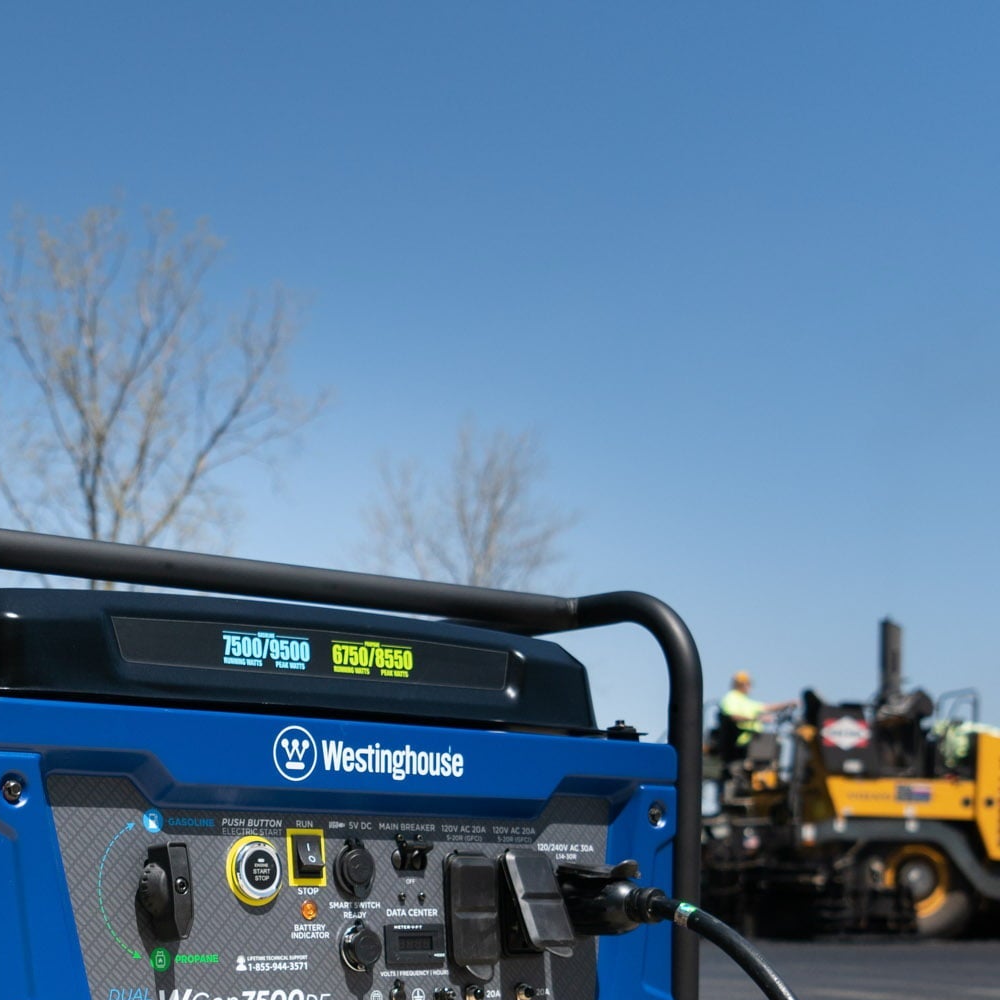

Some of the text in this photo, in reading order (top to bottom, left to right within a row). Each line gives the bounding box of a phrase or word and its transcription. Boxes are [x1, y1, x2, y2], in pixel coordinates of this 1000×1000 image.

[222, 634, 310, 662] 7500/9500
[332, 644, 413, 670] 6750/8550
[321, 740, 464, 781] Westinghouse
[168, 818, 216, 828] GASOLINE
[221, 818, 283, 828] PUSH BUTTON
[296, 820, 314, 828] RUN
[348, 822, 360, 830] 5V
[360, 822, 373, 830] DC
[379, 822, 436, 832] MAIN BREAKER
[222, 828, 282, 836] ELECTRIC START
[441, 824, 486, 834] 120V AC 20A
[492, 826, 508, 834] 120V
[510, 826, 521, 835] AC
[537, 843, 594, 853] 120/240V AC 30A
[298, 887, 319, 896] STOP
[328, 901, 380, 910] SMART SWITCH
[386, 908, 438, 917] DATA CENTER
[294, 924, 326, 932] BATTERY
[290, 932, 330, 940] INDICATOR
[175, 954, 220, 964] PROPANE
[248, 962, 308, 972] 1-855-944-3571
[486, 990, 502, 998] 20A
[536, 988, 550, 996] 20A
